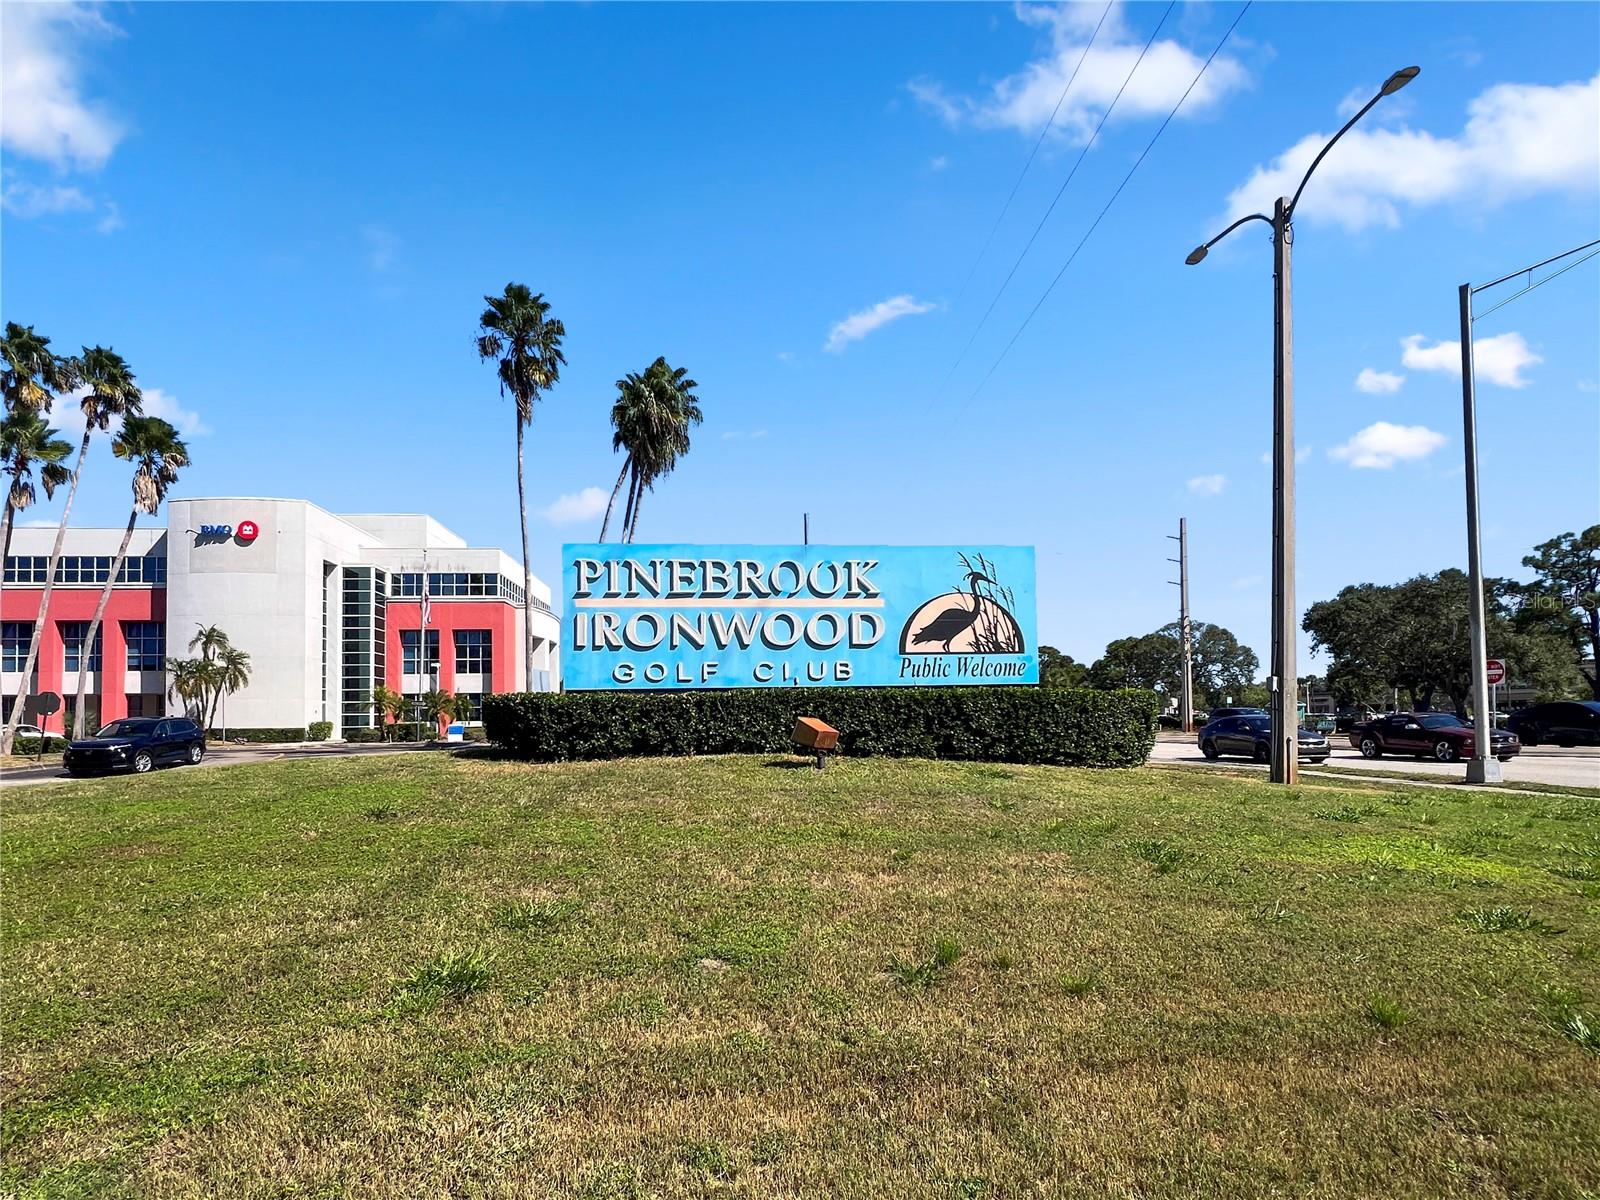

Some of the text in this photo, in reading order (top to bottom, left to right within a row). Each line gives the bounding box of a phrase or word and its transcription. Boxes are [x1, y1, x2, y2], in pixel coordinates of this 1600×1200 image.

[200, 525, 232, 535] BMO
[572, 559, 881, 599] PINEBROOK
[573, 611, 885, 652] IRONWOOD
[612, 661, 719, 684] GOLF
[899, 656, 1027, 678] Public Welcome
